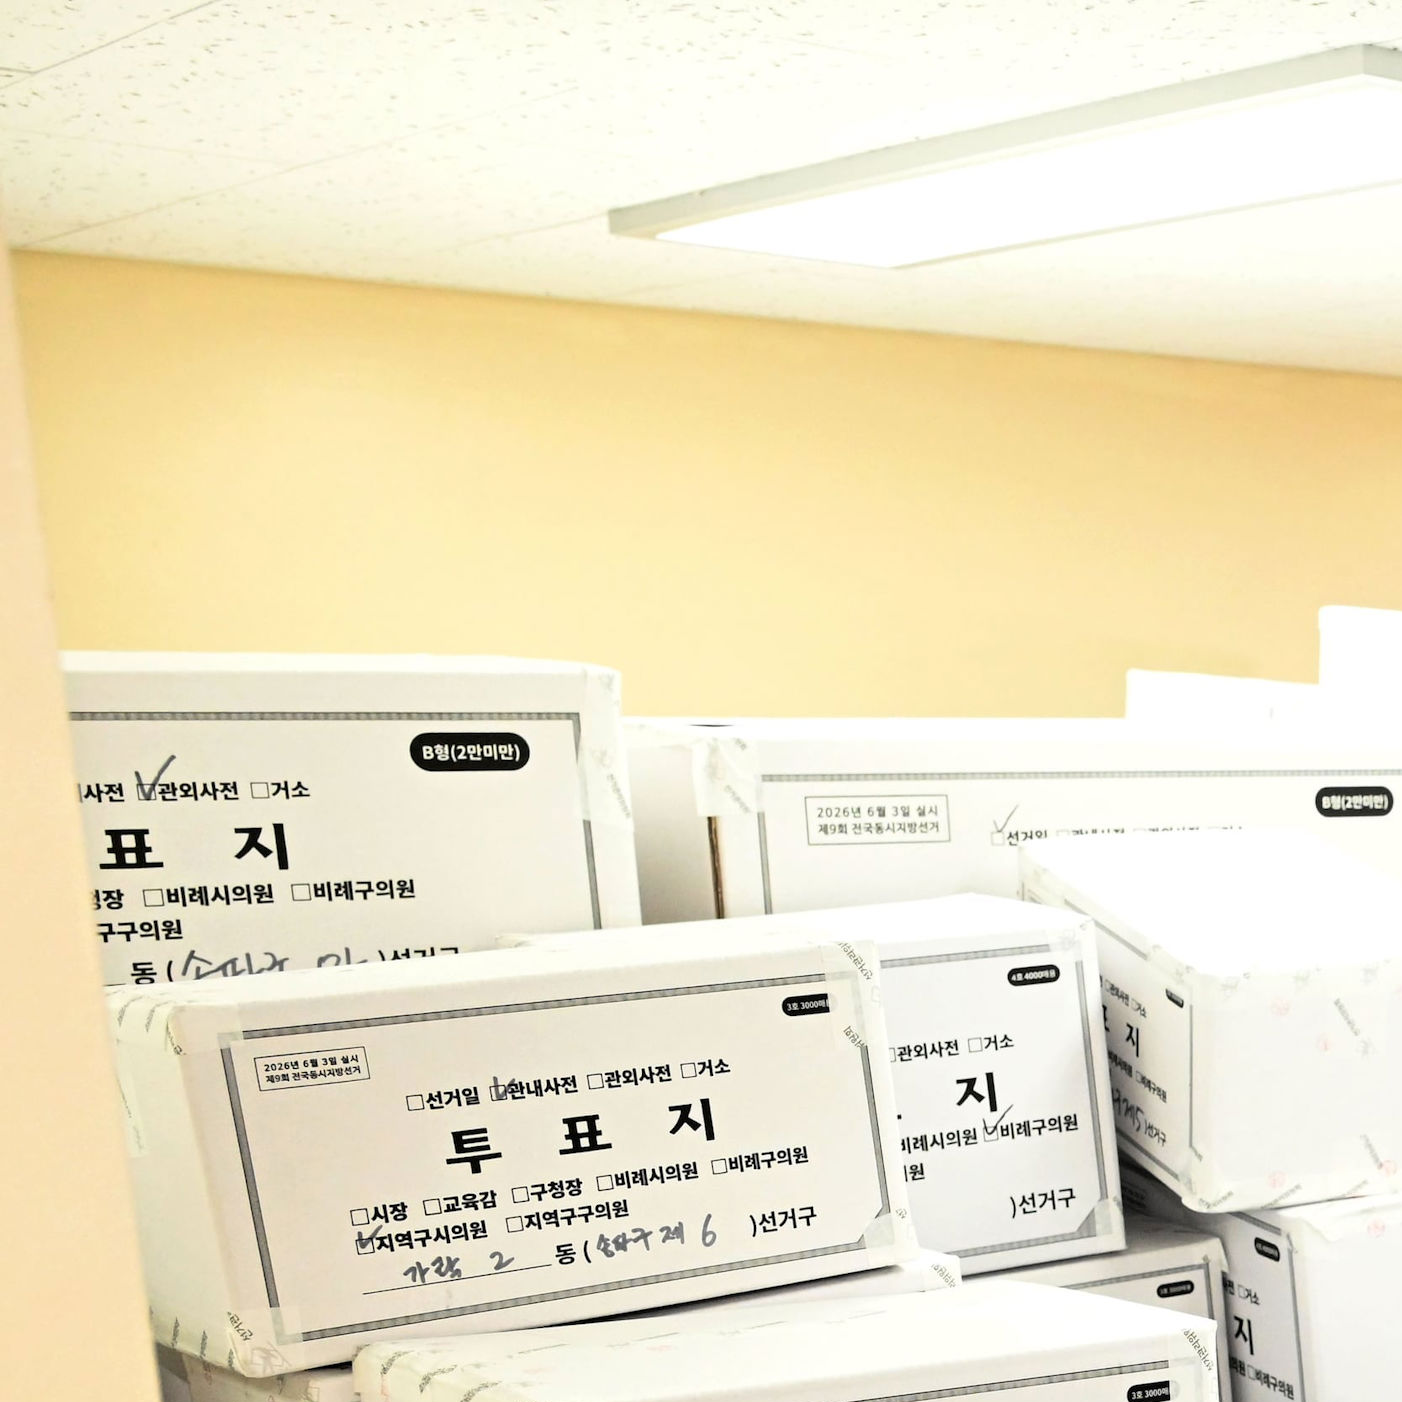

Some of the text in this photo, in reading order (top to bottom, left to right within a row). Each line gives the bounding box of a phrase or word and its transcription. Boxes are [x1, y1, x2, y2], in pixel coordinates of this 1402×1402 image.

[422, 743, 520, 762] B형(2만미만)
[158, 781, 310, 802] 관외사전 거소
[166, 880, 415, 905] 비례시의원 비례구의원
[897, 1035, 1014, 1062] 관외사전 거소
[264, 1054, 359, 1072] 2026년 6월 3일 실시
[266, 1065, 361, 1083] 제9회 전국동시지방선거
[426, 1059, 730, 1109] 선거일 관내사전 관외사전 거소
[1000, 1114, 1078, 1139] 비례구의원
[372, 1146, 808, 1223] 시장 교육감 구청장 비례시의원 비례구의원
[376, 1200, 629, 1251] 지역구시의원 지역구구의원
